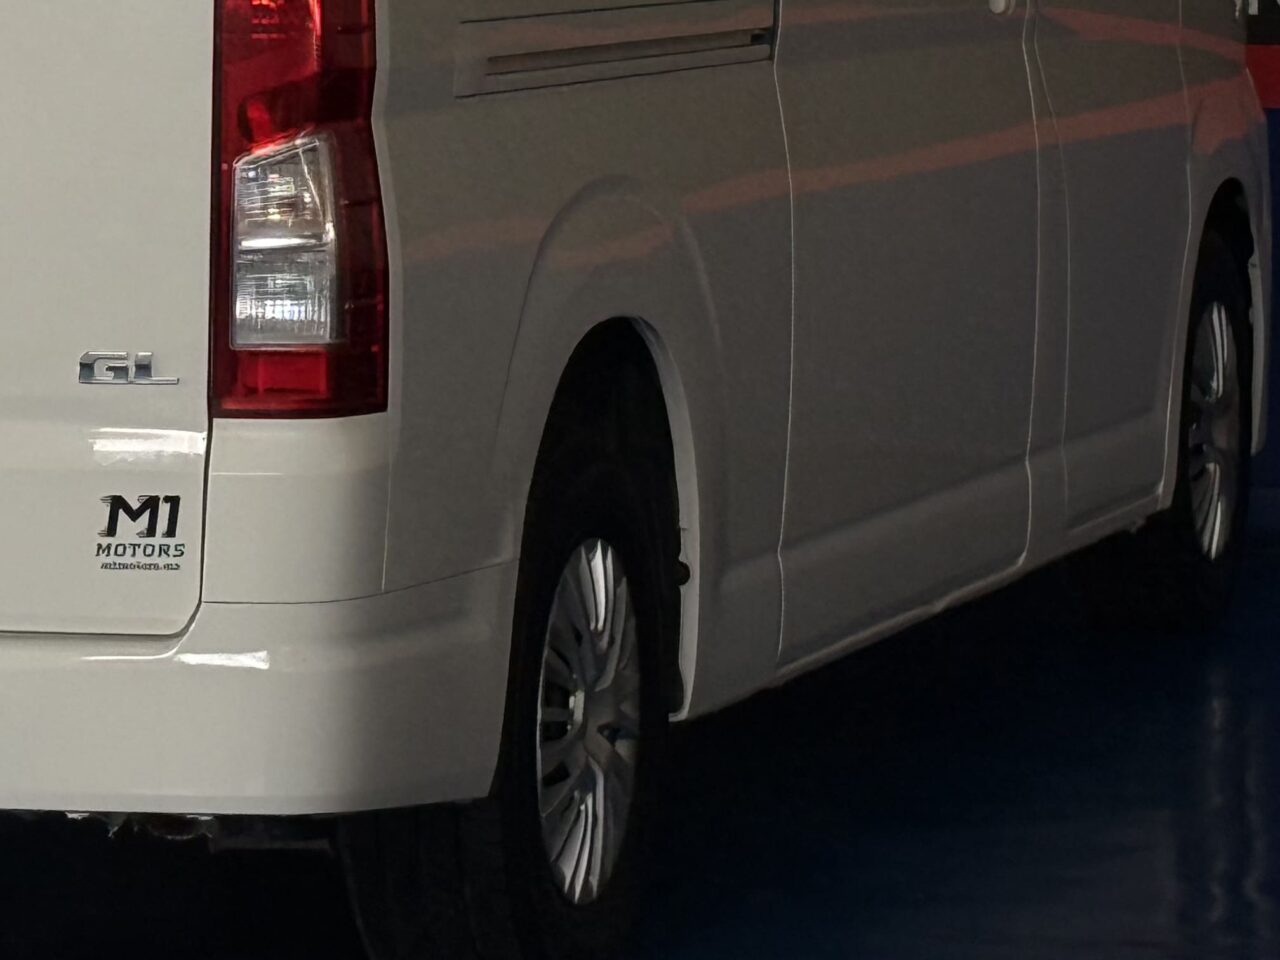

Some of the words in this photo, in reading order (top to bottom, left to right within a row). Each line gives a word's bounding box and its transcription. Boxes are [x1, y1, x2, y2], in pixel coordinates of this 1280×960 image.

[79, 351, 180, 385] GL
[97, 495, 181, 538] M1
[95, 542, 186, 558] MOTORS
